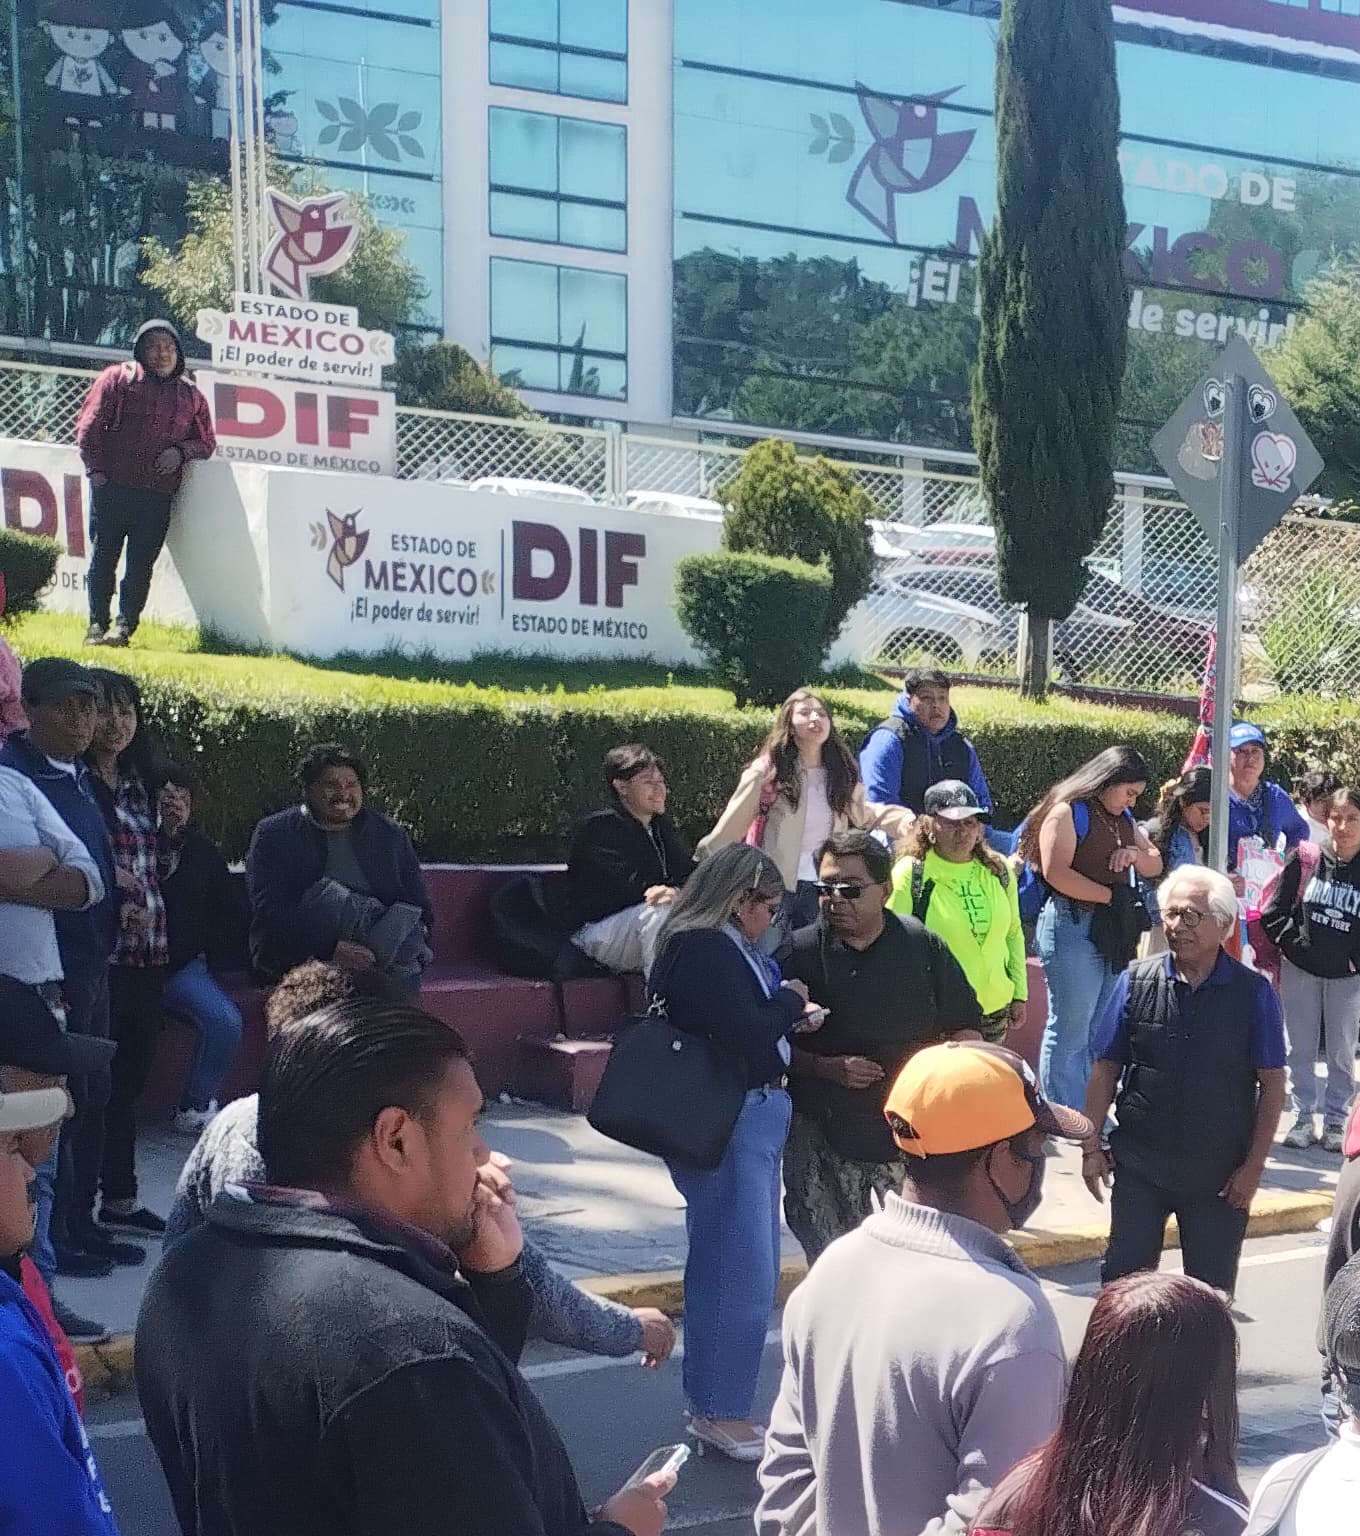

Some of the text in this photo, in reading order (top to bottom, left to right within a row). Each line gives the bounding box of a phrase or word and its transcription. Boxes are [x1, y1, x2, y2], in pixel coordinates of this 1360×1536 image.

[1118, 151, 1297, 210] TADO DE
[908, 260, 960, 308] ¡El
[240, 300, 351, 327] ESTADO DE
[219, 345, 374, 378] ¡El poder de servir!
[213, 382, 380, 450] DIF
[215, 446, 284, 466] ESTADO
[286, 452, 308, 467] DE
[391, 533, 477, 558] ESTADO DE
[512, 520, 647, 609] DIF
[350, 597, 480, 626] ¡El poder de servir!
[512, 613, 648, 639] ESTADO DE MÉXICO
